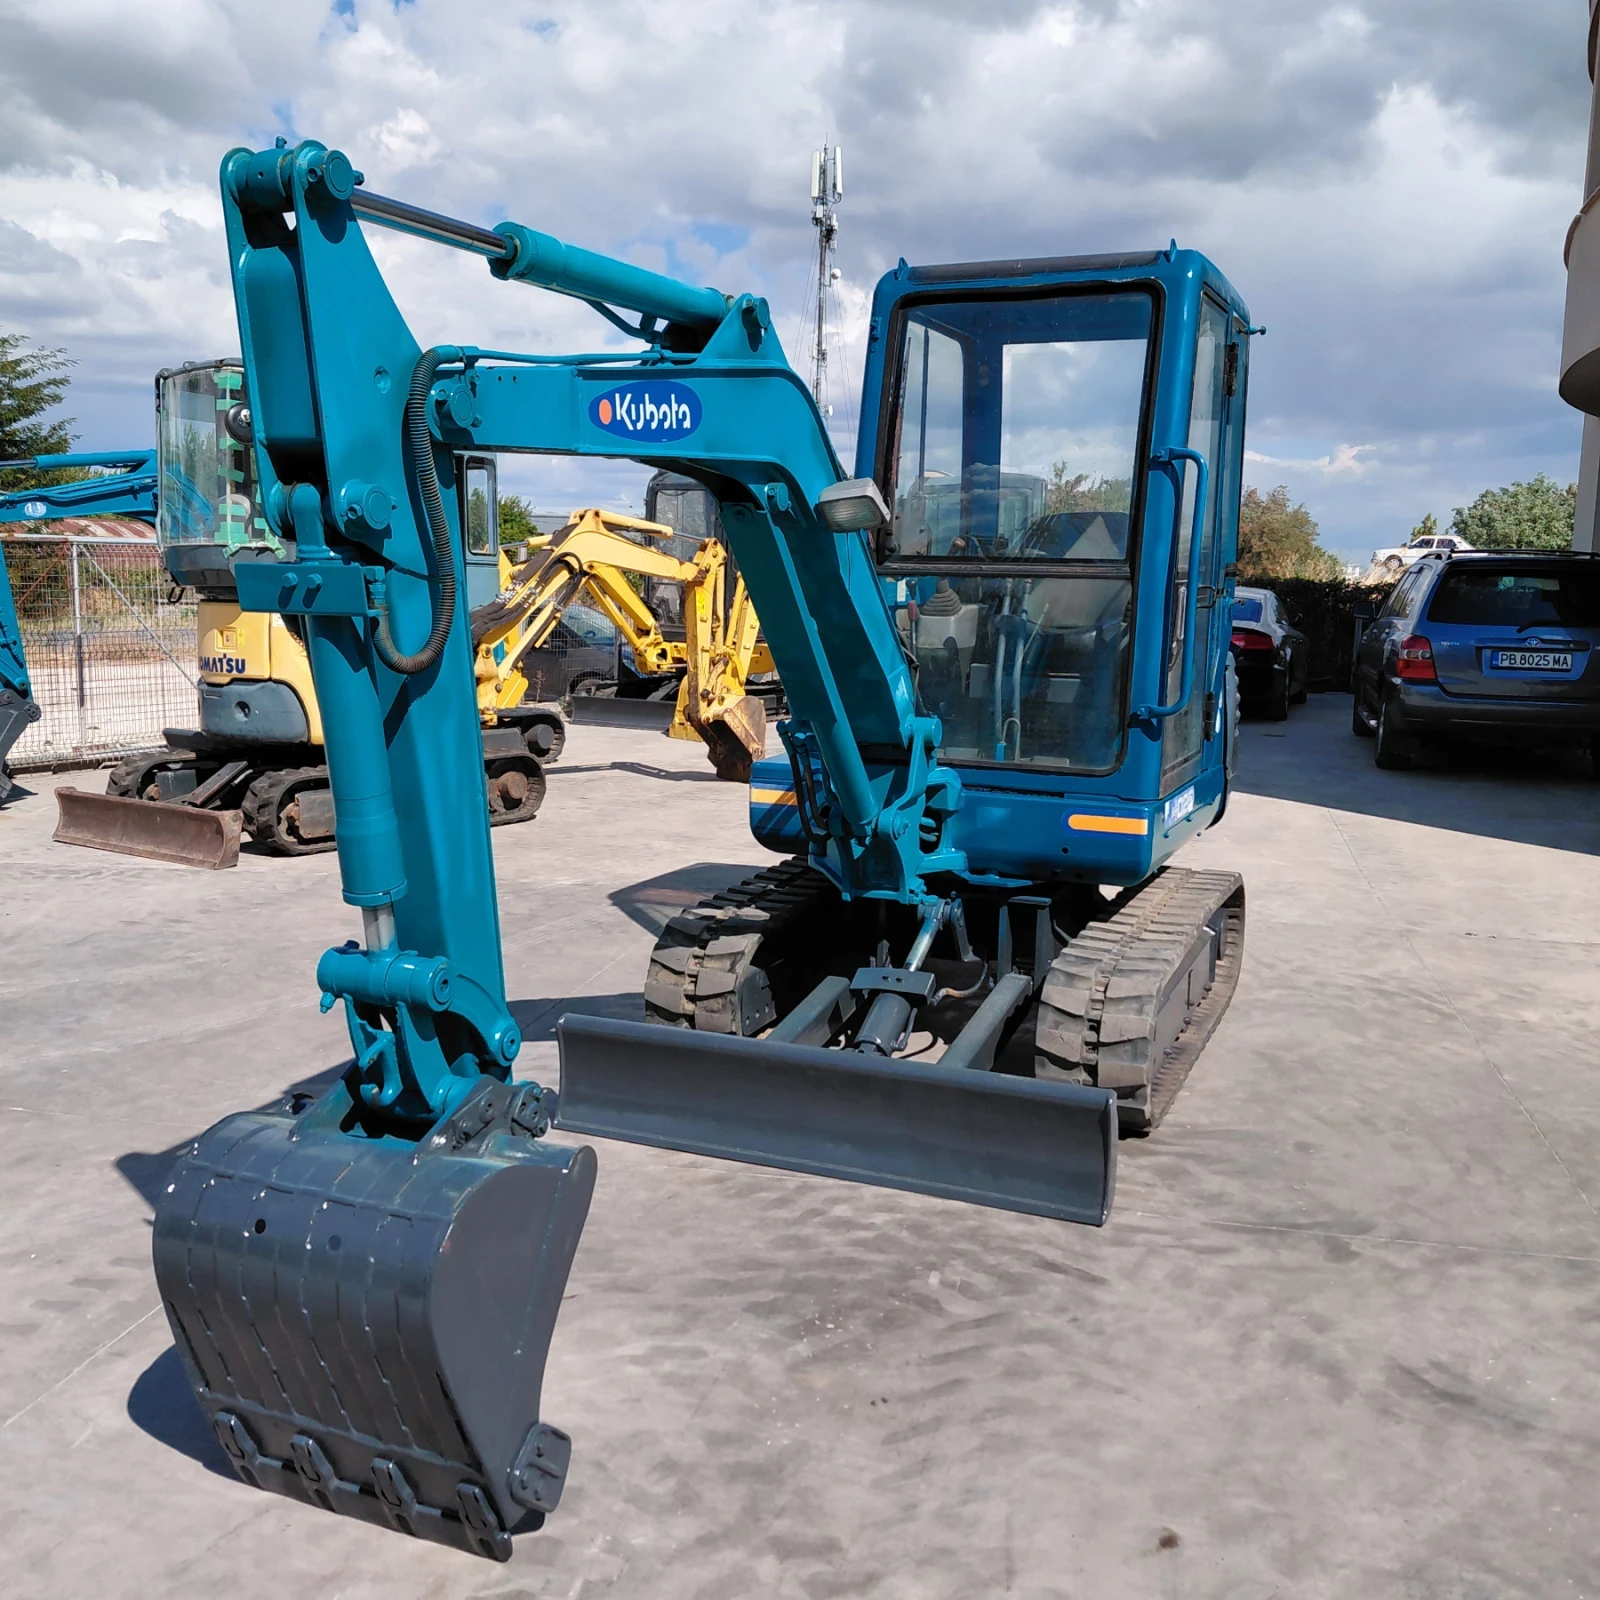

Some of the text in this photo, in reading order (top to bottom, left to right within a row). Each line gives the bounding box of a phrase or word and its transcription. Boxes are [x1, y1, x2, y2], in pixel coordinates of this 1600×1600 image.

[615, 393, 691, 431] Kubota
[199, 653, 246, 674] OMATSU
[1519, 654, 1550, 667] 8025
[1552, 655, 1569, 668] MA
